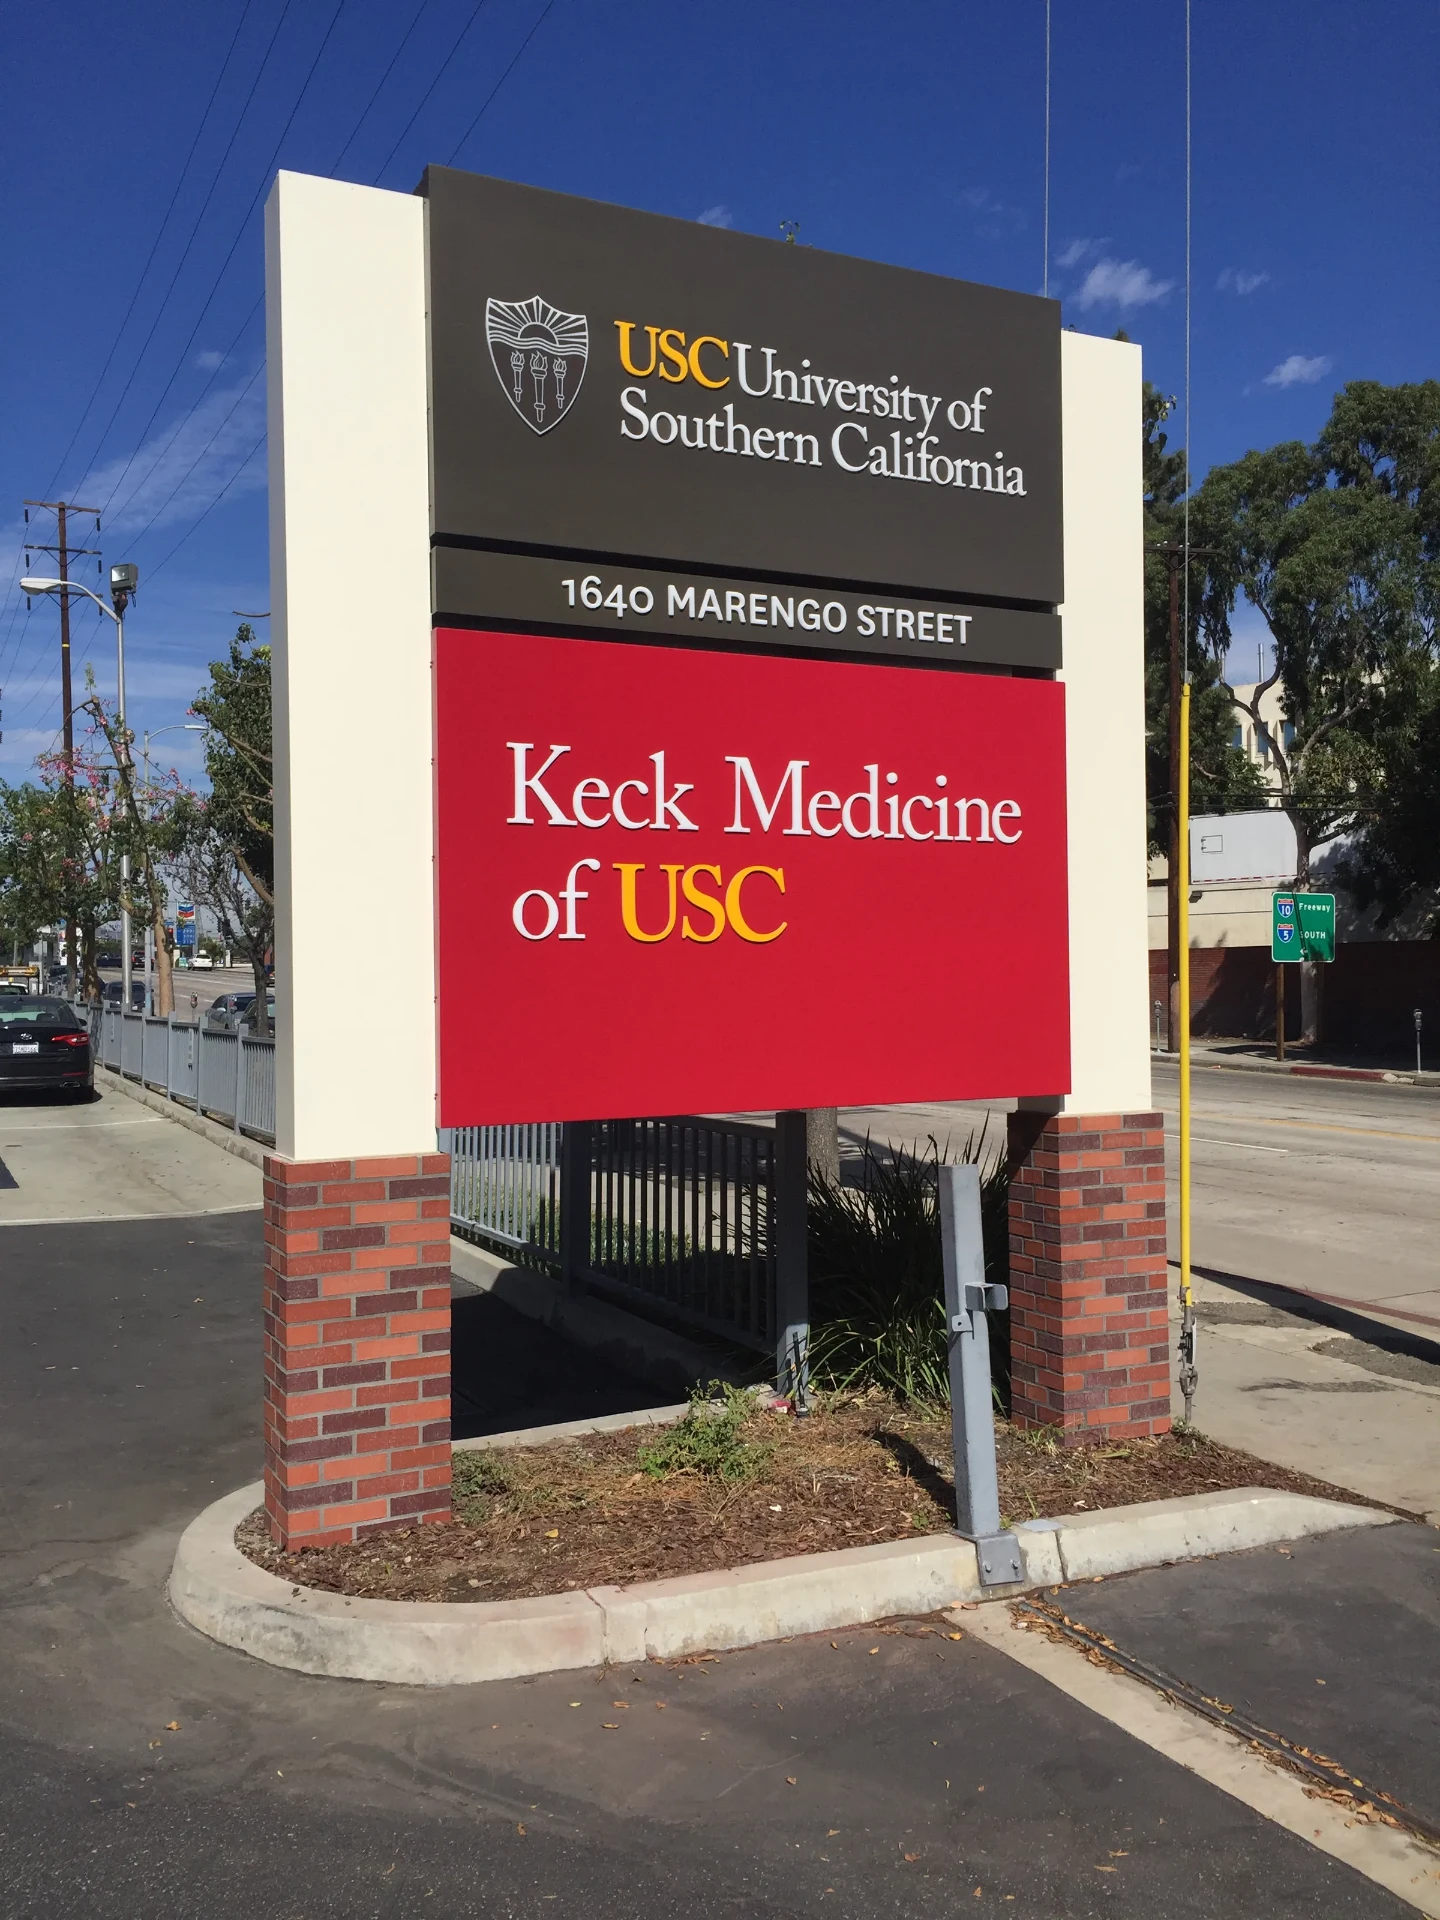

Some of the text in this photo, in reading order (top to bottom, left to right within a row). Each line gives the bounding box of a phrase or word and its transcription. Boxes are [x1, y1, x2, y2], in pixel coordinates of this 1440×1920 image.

[614, 319, 993, 441] USC University of
[620, 386, 1028, 497] Southern California
[561, 575, 973, 644] 1640 MARENGO STREET
[506, 741, 1024, 844] Keck Medicine
[512, 857, 789, 943] of USC
[1281, 902, 1331, 915] 10 Freeway
